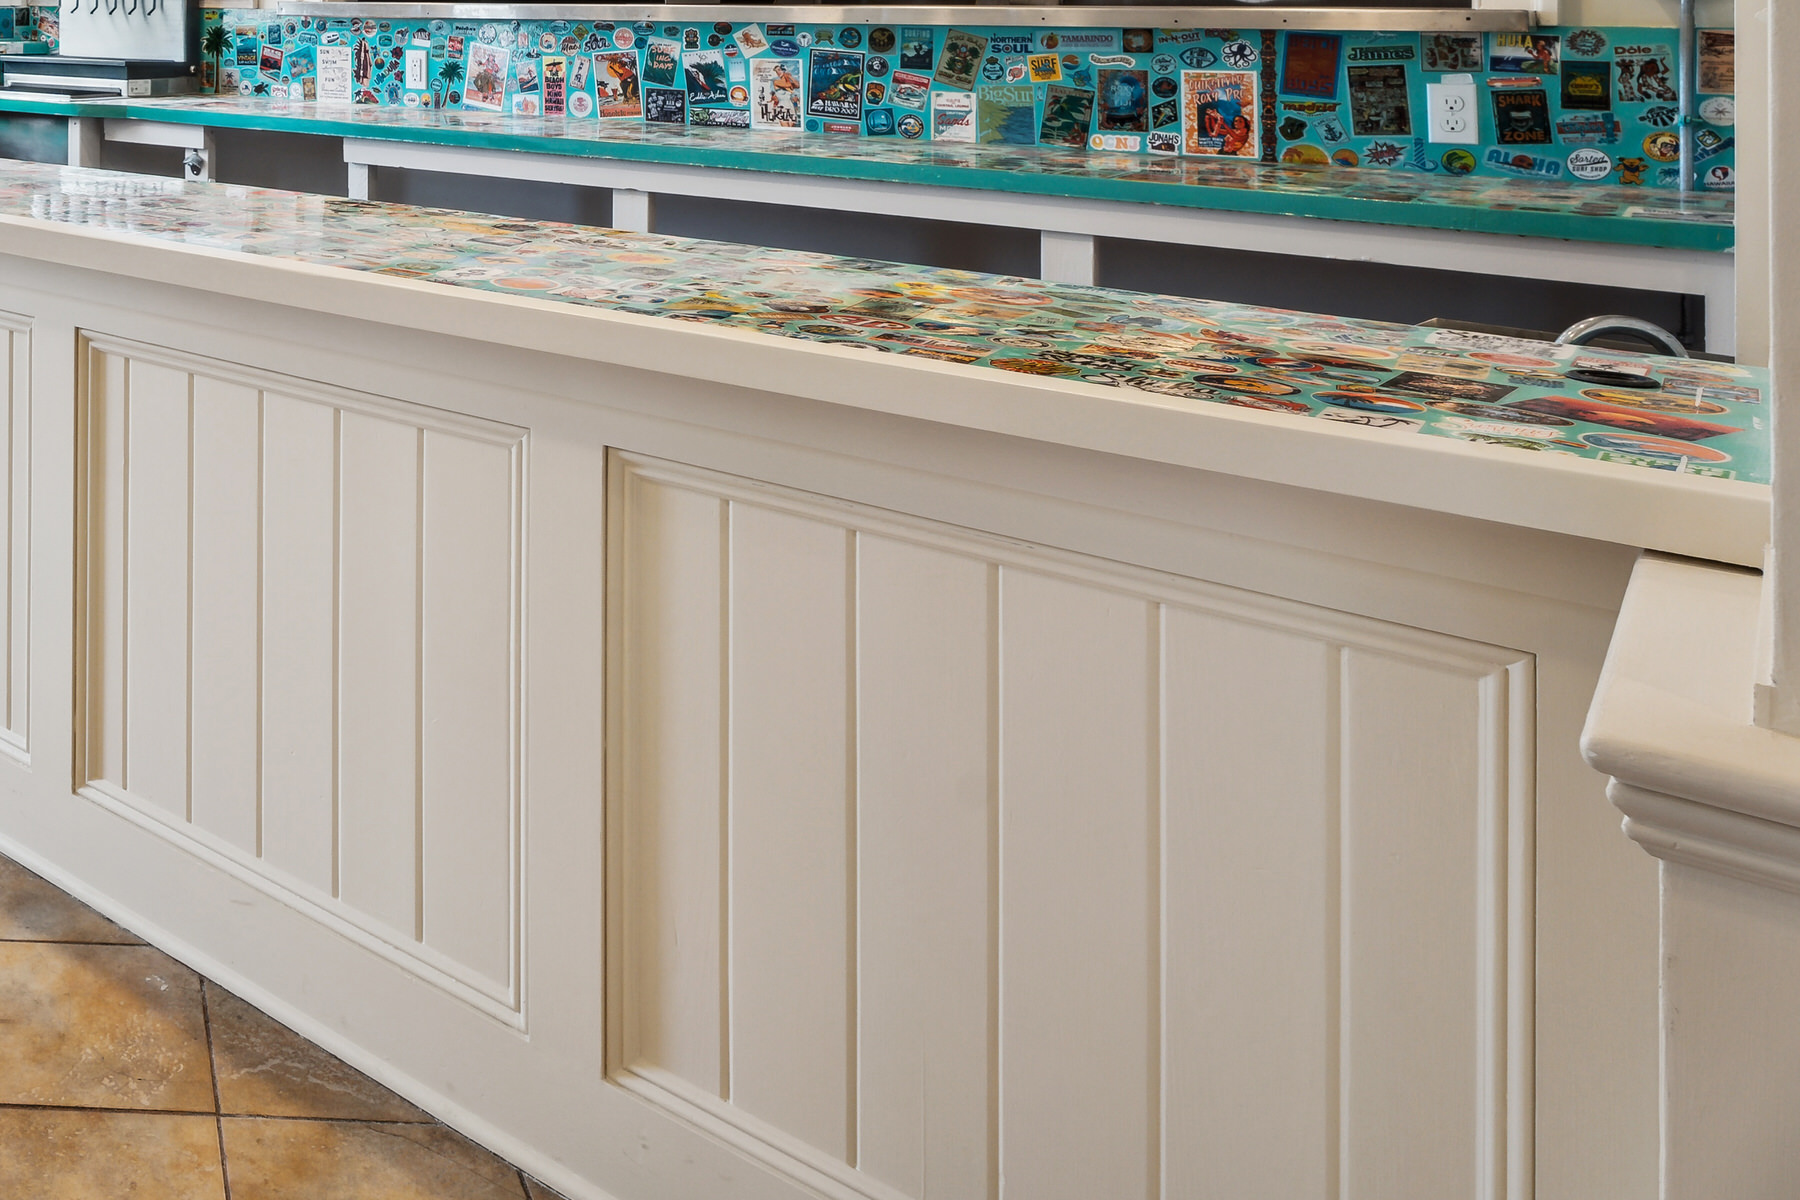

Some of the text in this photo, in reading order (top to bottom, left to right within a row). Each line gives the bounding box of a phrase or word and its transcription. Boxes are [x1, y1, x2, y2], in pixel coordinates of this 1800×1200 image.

[990, 32, 1033, 43] NORTHERN
[1060, 34, 1113, 43] TAMARINDO
[1158, 32, 1200, 43] IN-N-OUT
[1496, 34, 1533, 48] HULA
[652, 45, 676, 54] SURF
[991, 44, 1033, 54] SOUL
[1349, 47, 1414, 60] James
[653, 61, 674, 70] DAYS
[1030, 58, 1057, 71] SURF
[1193, 91, 1219, 104] ROXY
[1498, 94, 1542, 107] SHARK
[825, 100, 858, 109] HAWAIIAN
[938, 113, 970, 126] Sands
[1091, 135, 1139, 150] OCNJ
[1503, 131, 1545, 141] ZONE
[1487, 149, 1560, 176] ALOHA
[824, 315, 906, 329] STP
